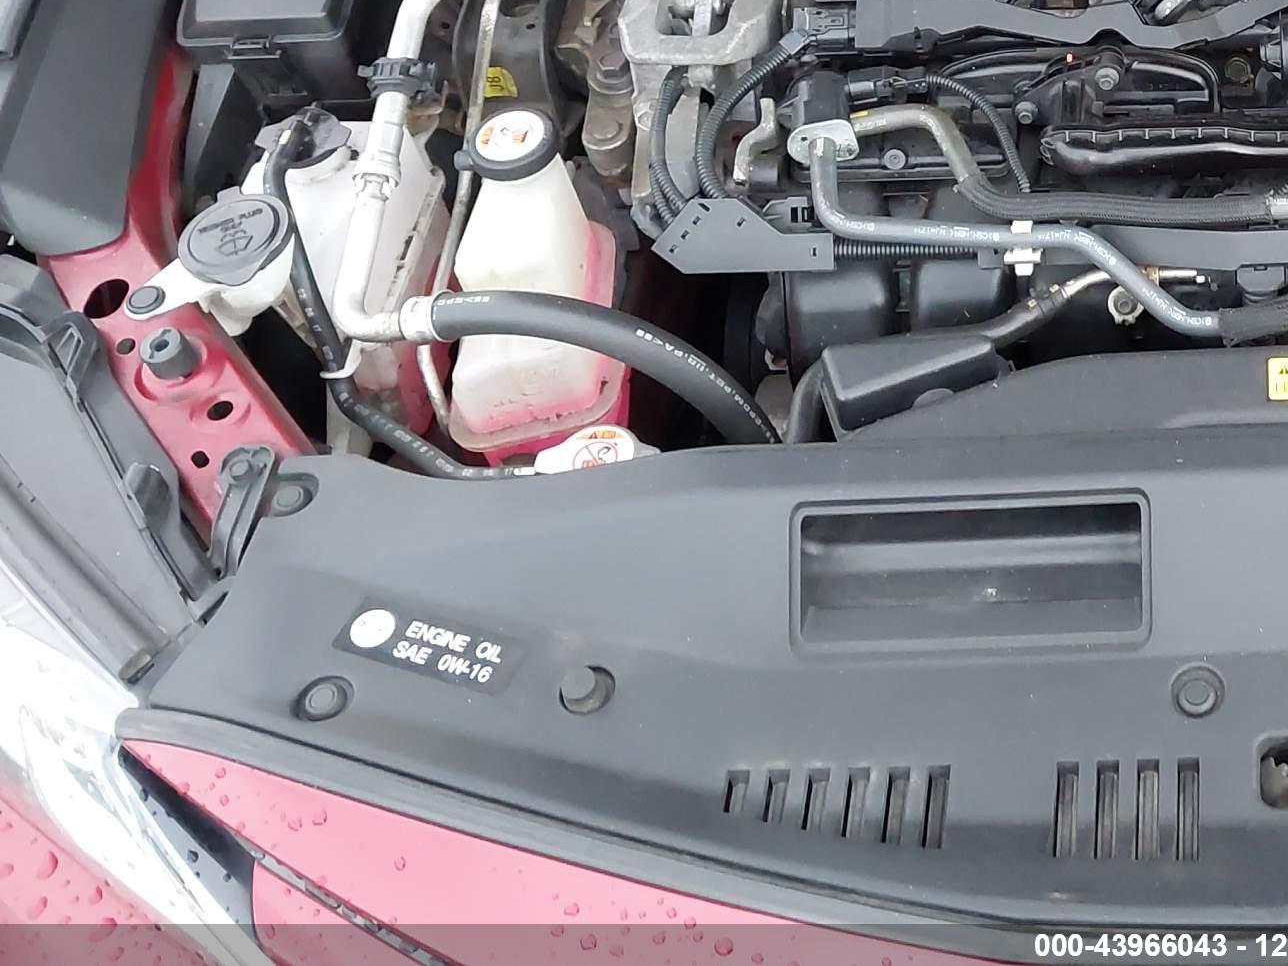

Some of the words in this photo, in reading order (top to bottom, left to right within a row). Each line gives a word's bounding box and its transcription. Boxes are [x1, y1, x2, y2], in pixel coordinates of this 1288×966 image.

[392, 640, 433, 665] SAE
[437, 654, 493, 683] 0W-16
[405, 620, 471, 652] ENGINE
[475, 641, 502, 664] OIL
